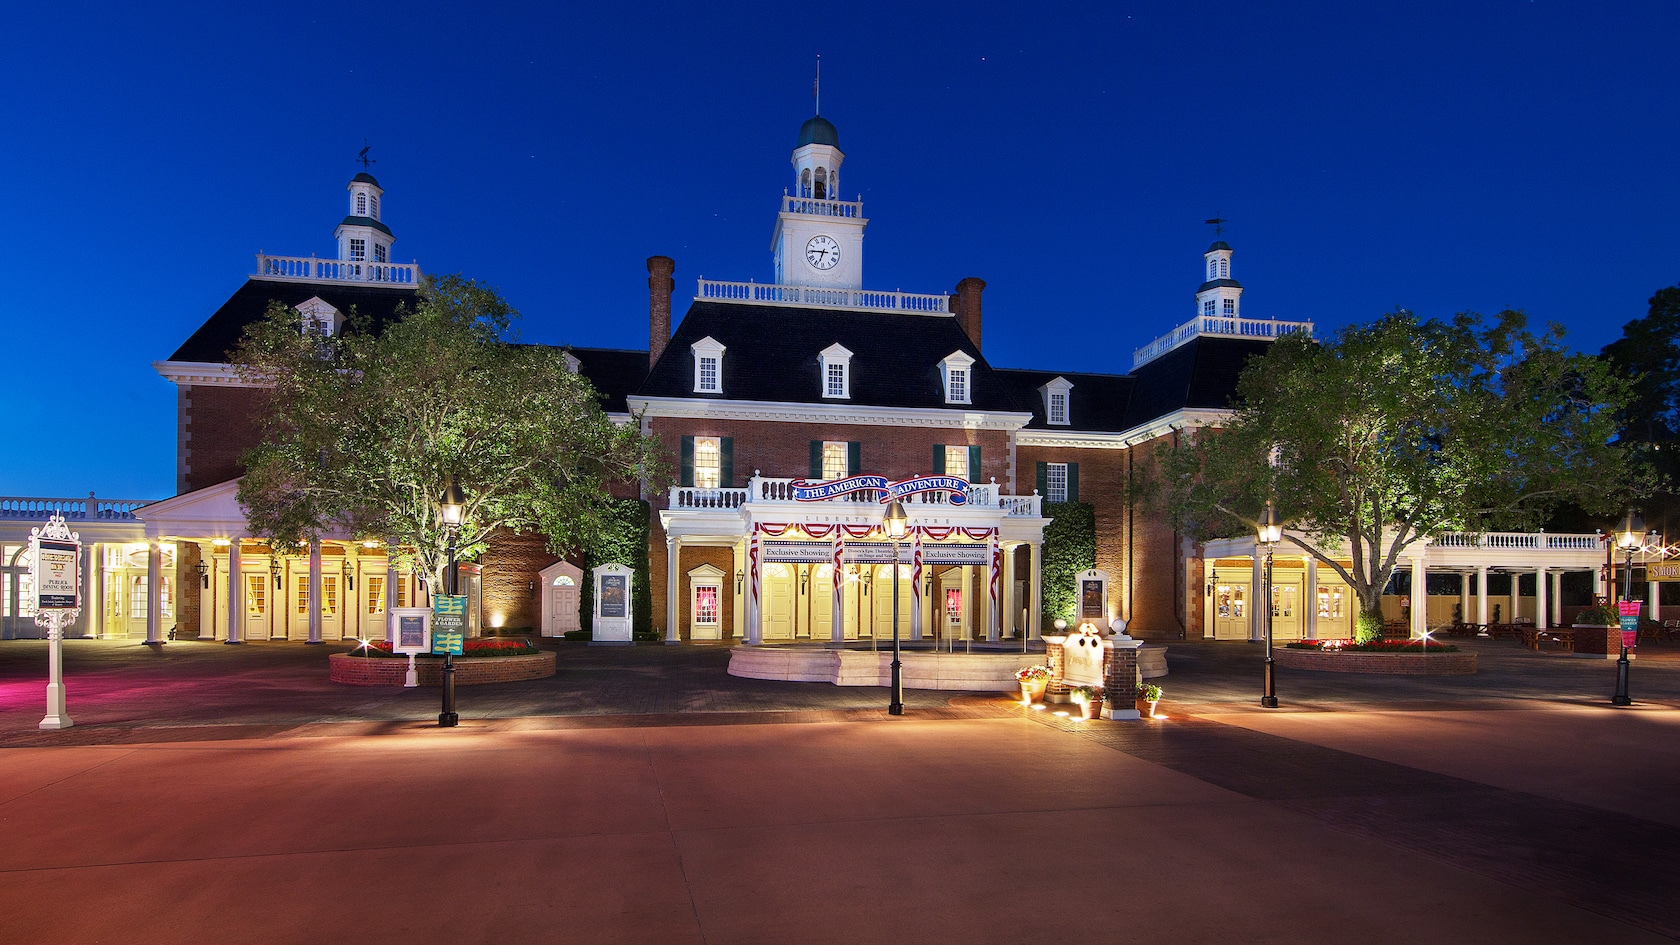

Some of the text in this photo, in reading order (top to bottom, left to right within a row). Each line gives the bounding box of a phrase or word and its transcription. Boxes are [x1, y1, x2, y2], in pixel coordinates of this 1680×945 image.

[804, 479, 959, 499] THE AMERICAN ADVENTURE
[805, 515, 869, 523] LIBERTY
[766, 548, 830, 557] Exclusive Showing
[925, 550, 985, 560] Exclusive Showing
[1652, 565, 1680, 578] SMOK
